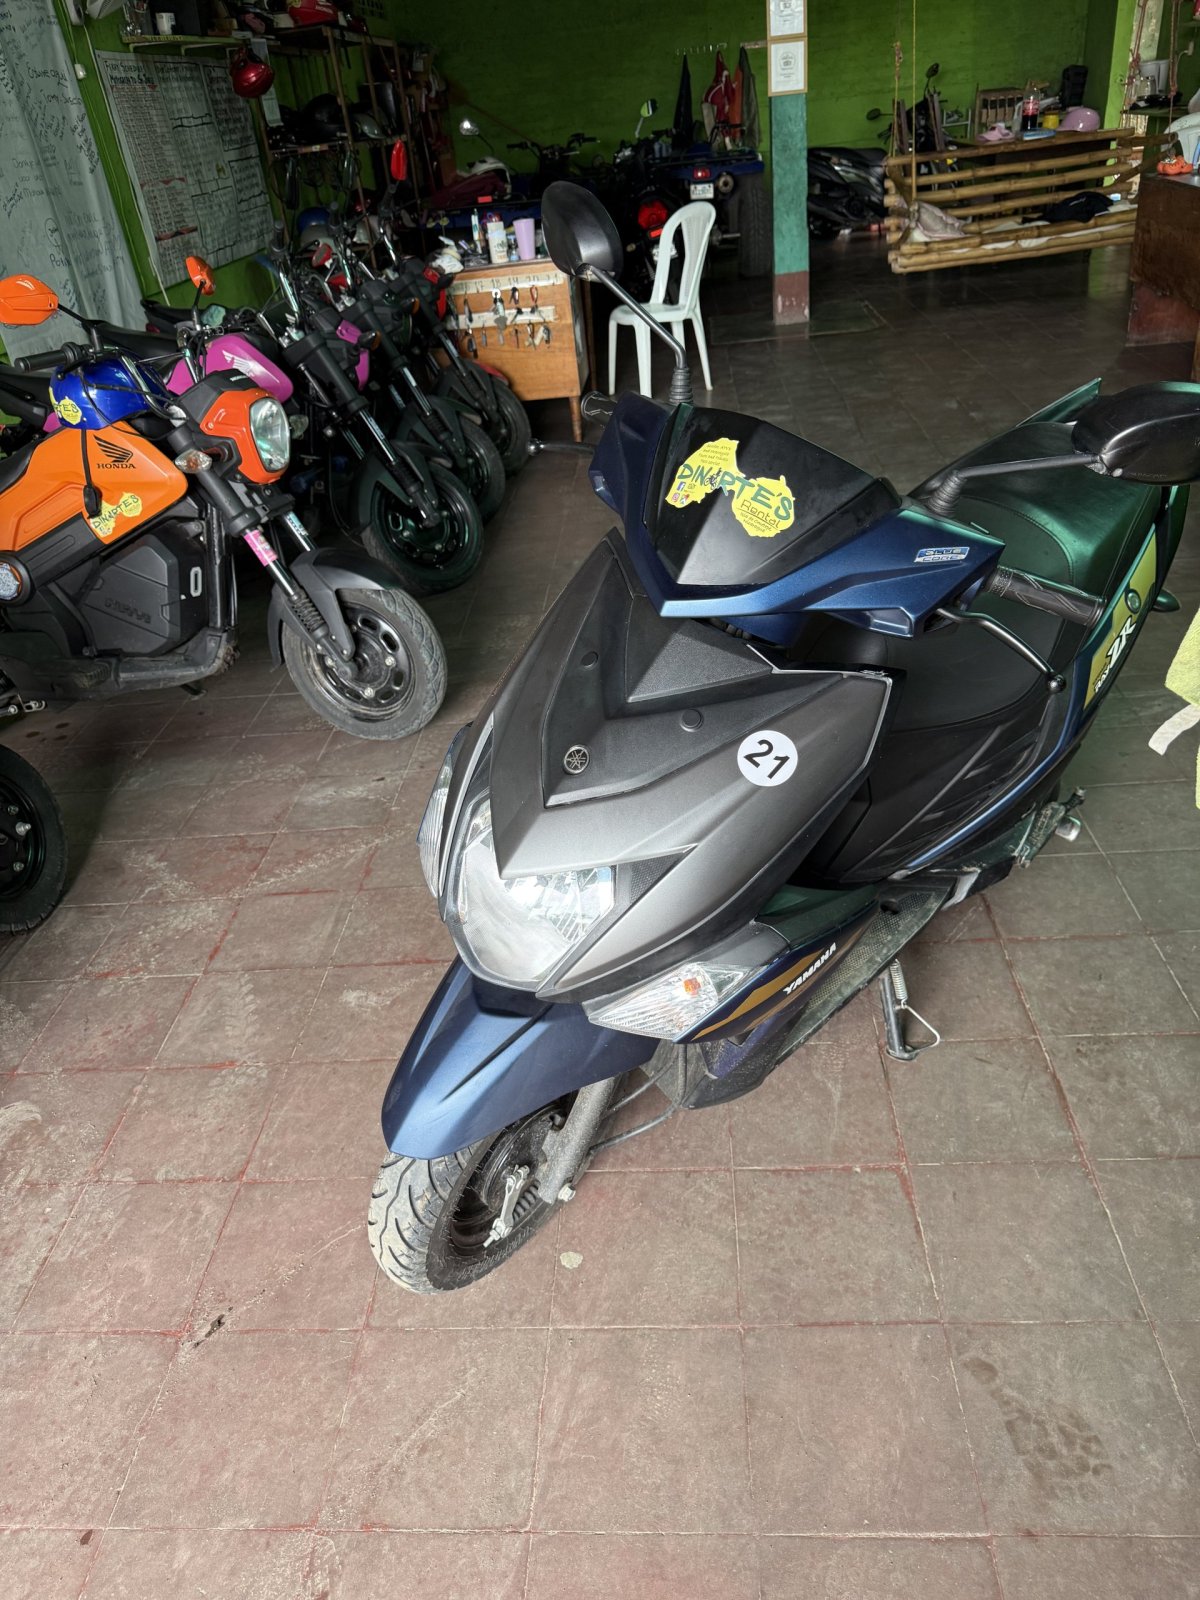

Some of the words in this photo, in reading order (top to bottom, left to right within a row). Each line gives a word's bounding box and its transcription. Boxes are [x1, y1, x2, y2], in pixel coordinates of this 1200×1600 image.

[677, 463, 793, 521] DINRTE'S
[741, 499, 781, 528] Rental
[744, 739, 790, 779] 21
[783, 942, 837, 995] YAMAHA
